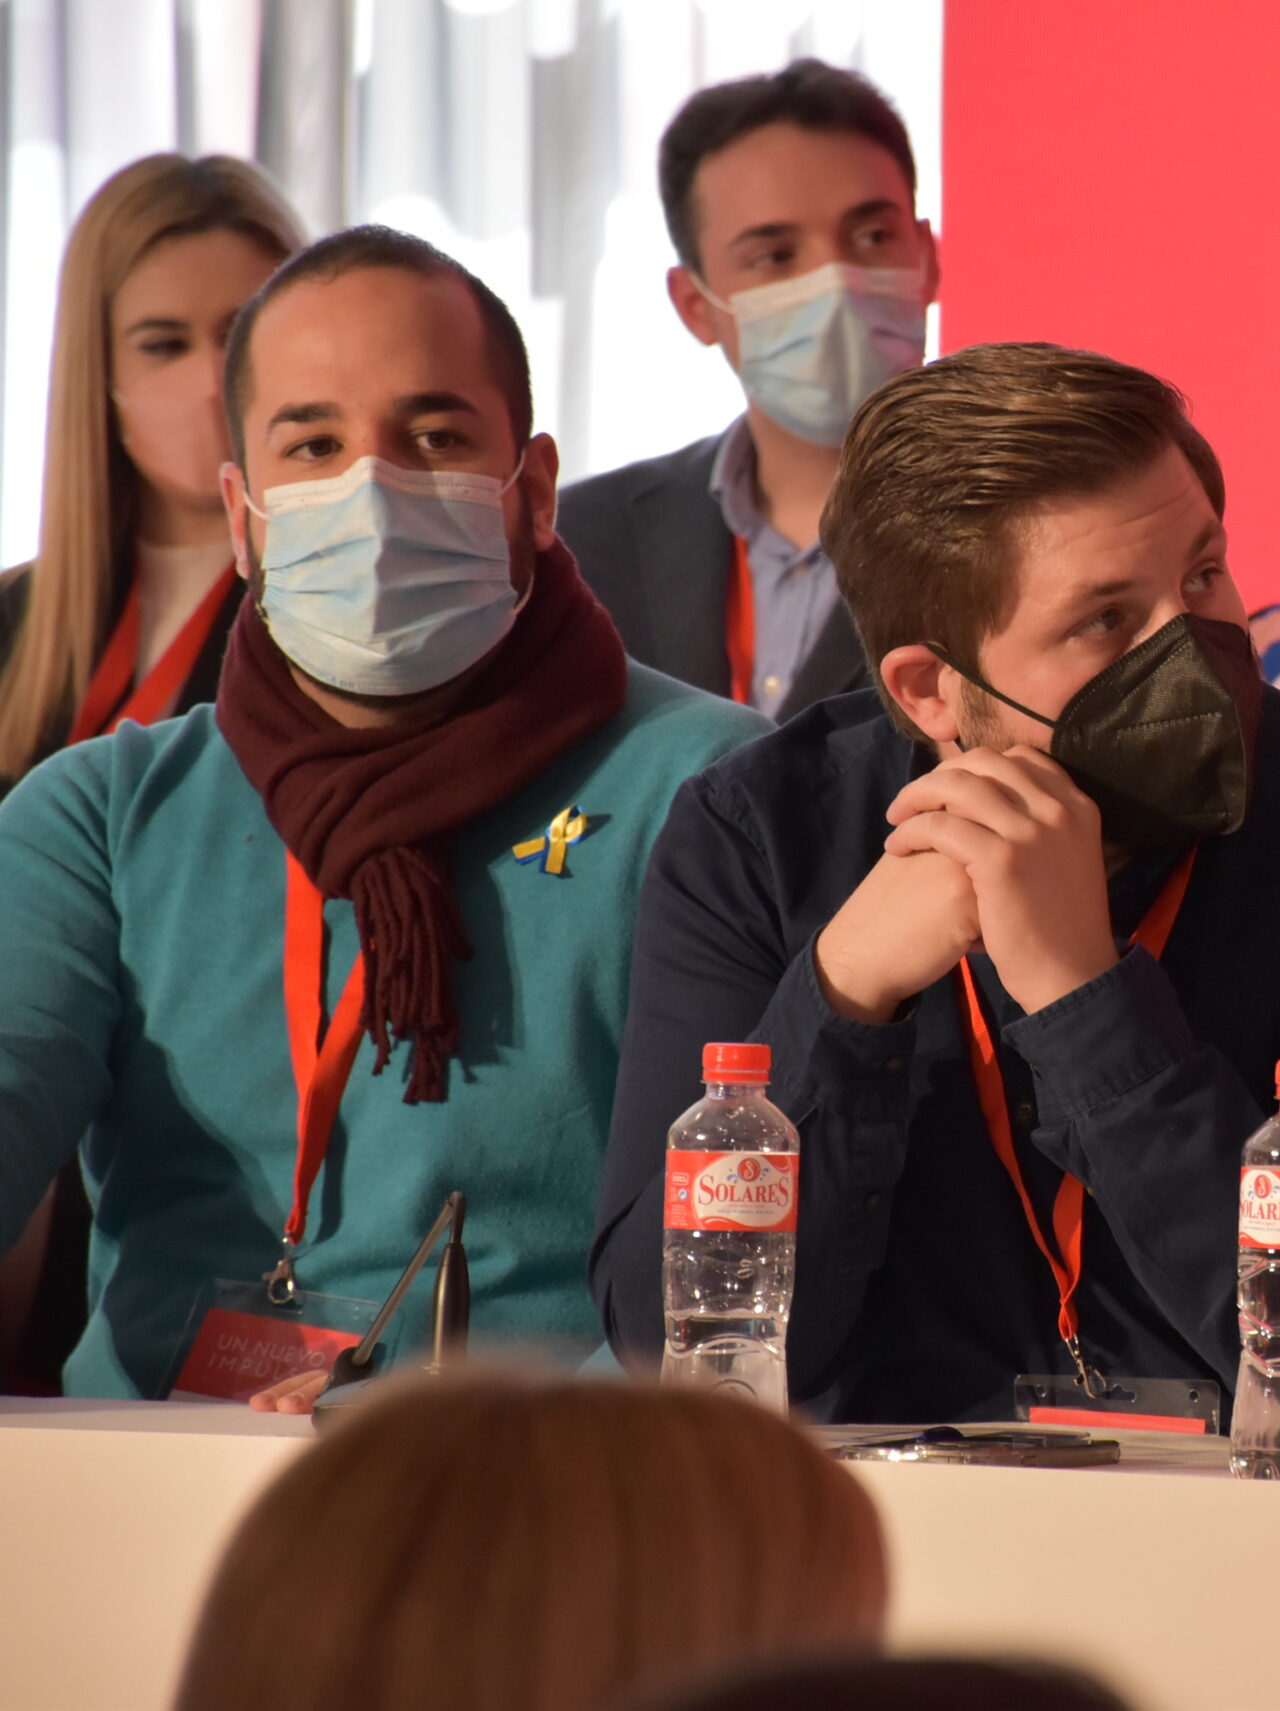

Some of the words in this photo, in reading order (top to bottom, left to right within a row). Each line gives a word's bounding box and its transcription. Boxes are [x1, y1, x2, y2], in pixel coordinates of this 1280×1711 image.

[698, 1174, 789, 1207] SOLARES
[217, 1333, 249, 1352] UN
[253, 1340, 326, 1367] NUEVO
[208, 1352, 299, 1382] IMPULS
